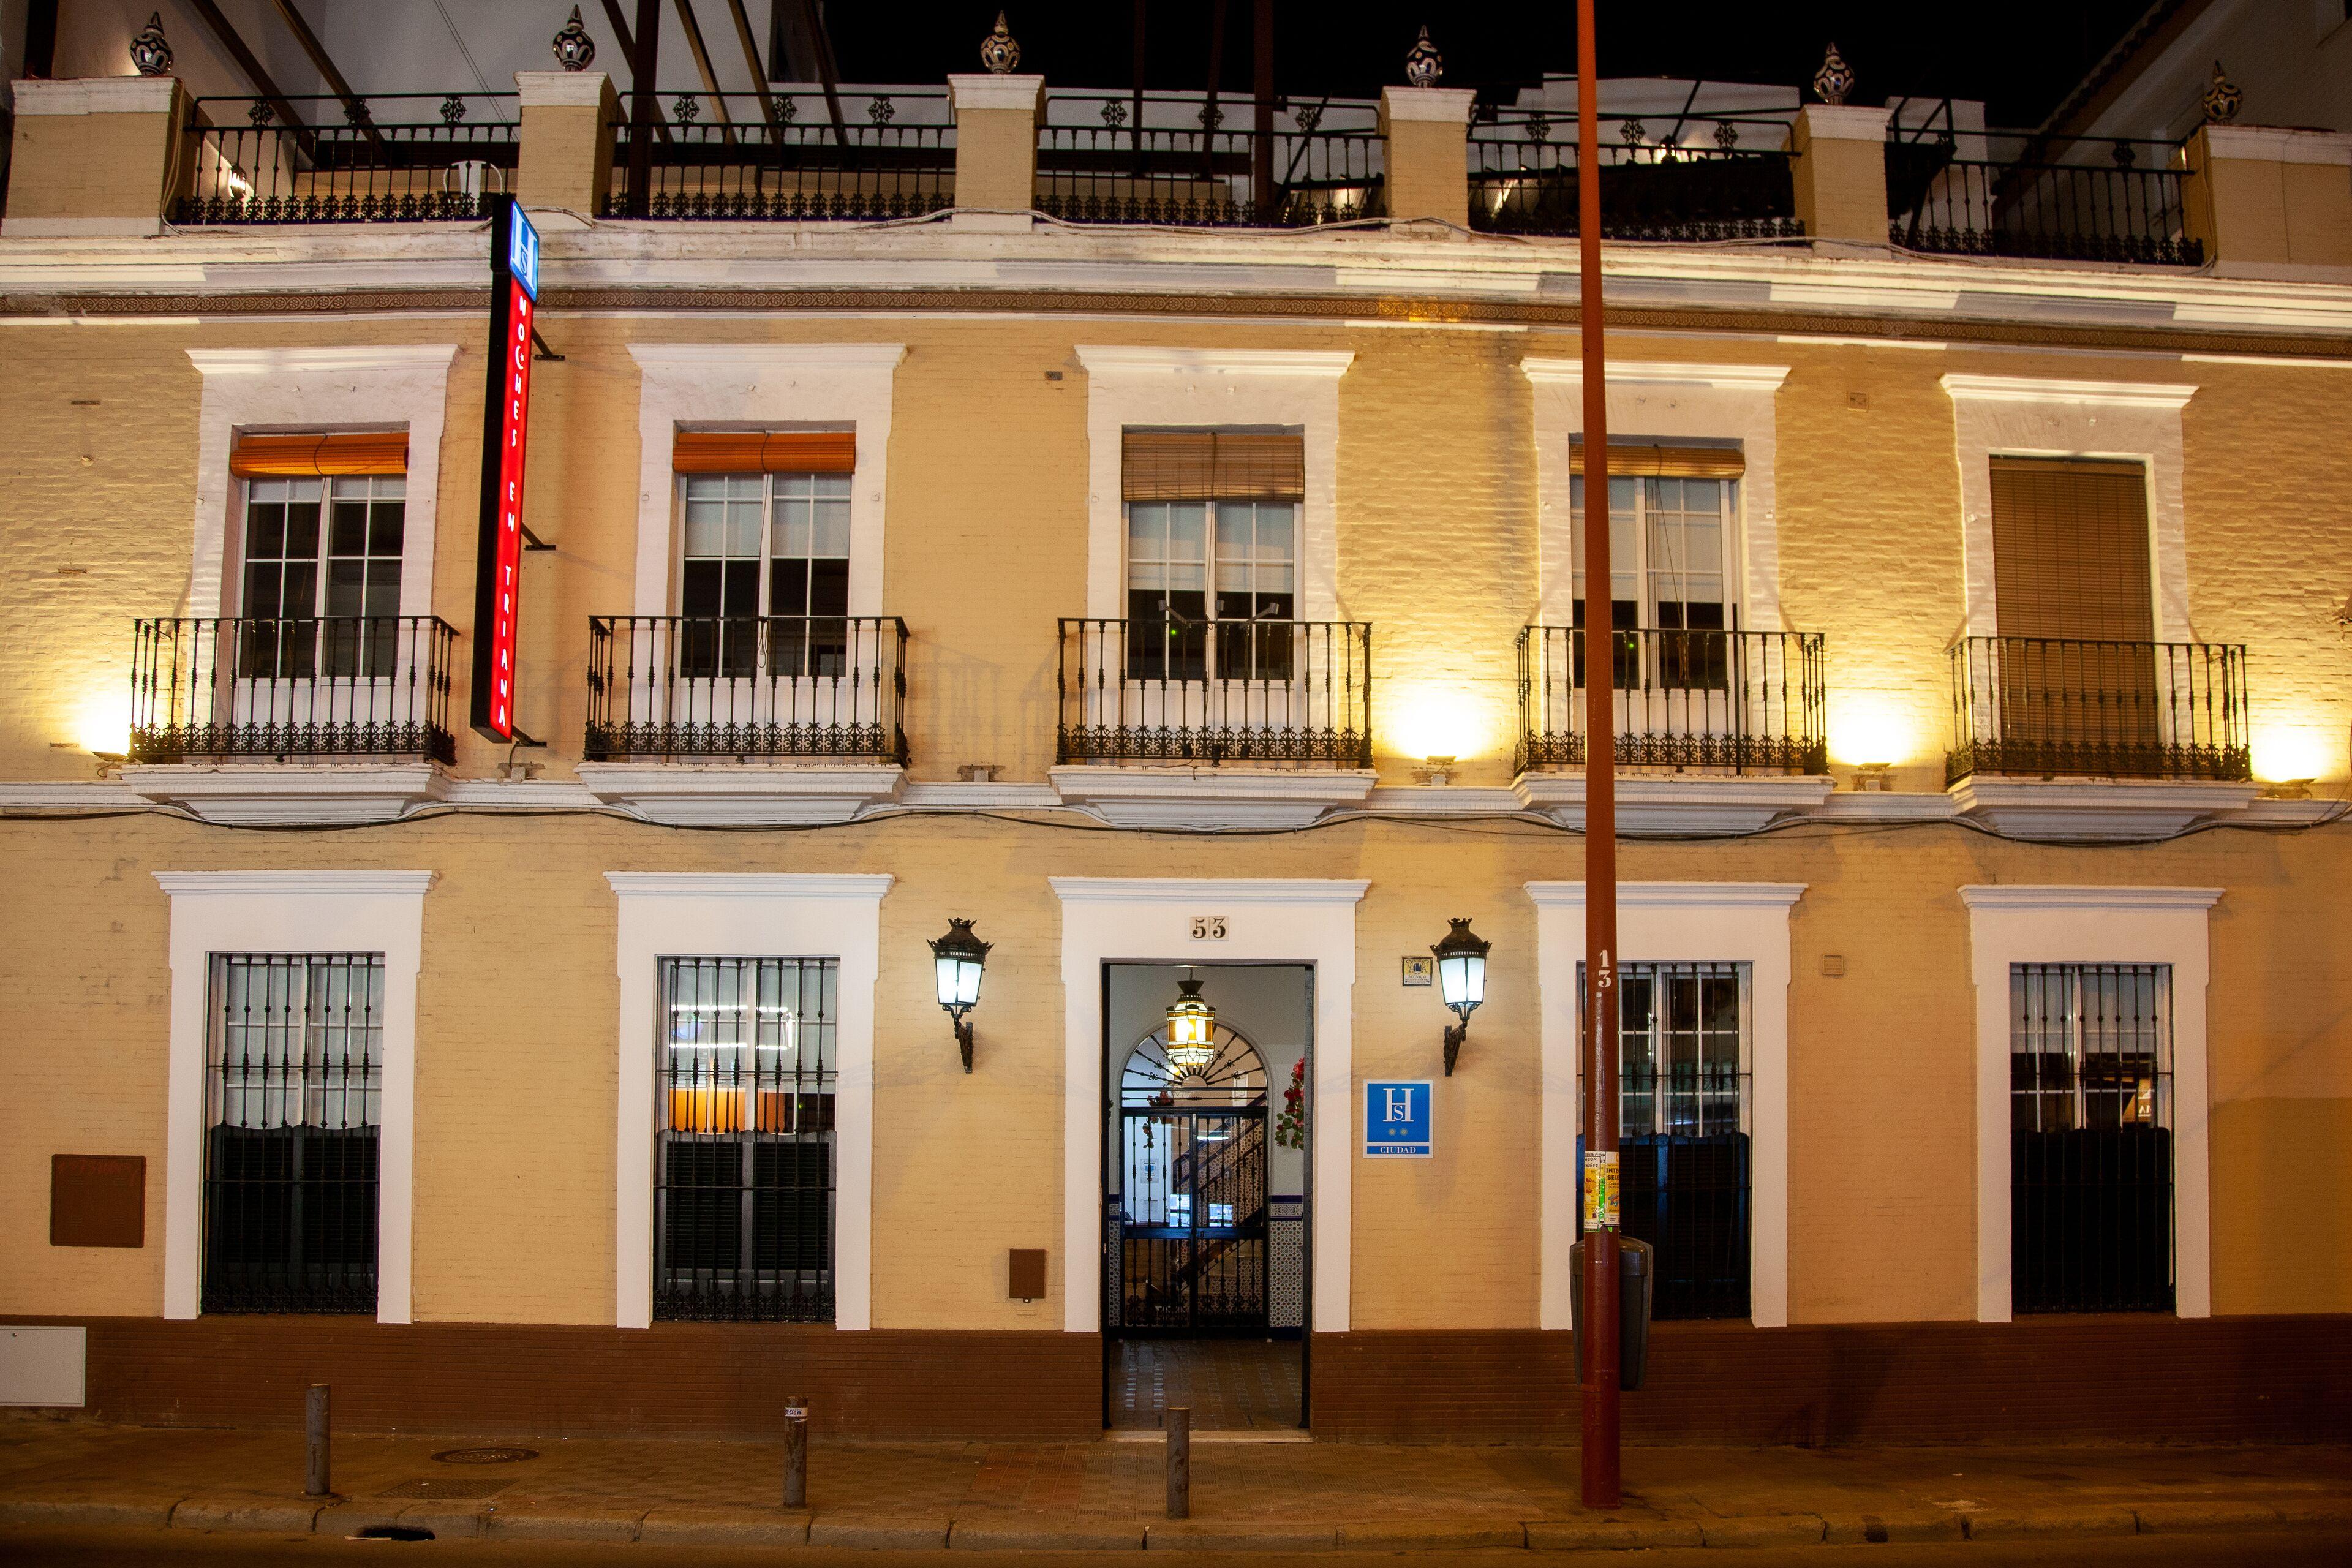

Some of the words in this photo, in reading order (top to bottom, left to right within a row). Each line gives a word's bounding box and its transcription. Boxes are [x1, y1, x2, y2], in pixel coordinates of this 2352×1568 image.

[511, 295, 527, 447] NOCHES
[508, 481, 516, 532] EN
[499, 565, 512, 727] TRIANA
[1192, 918, 1226, 938] 53
